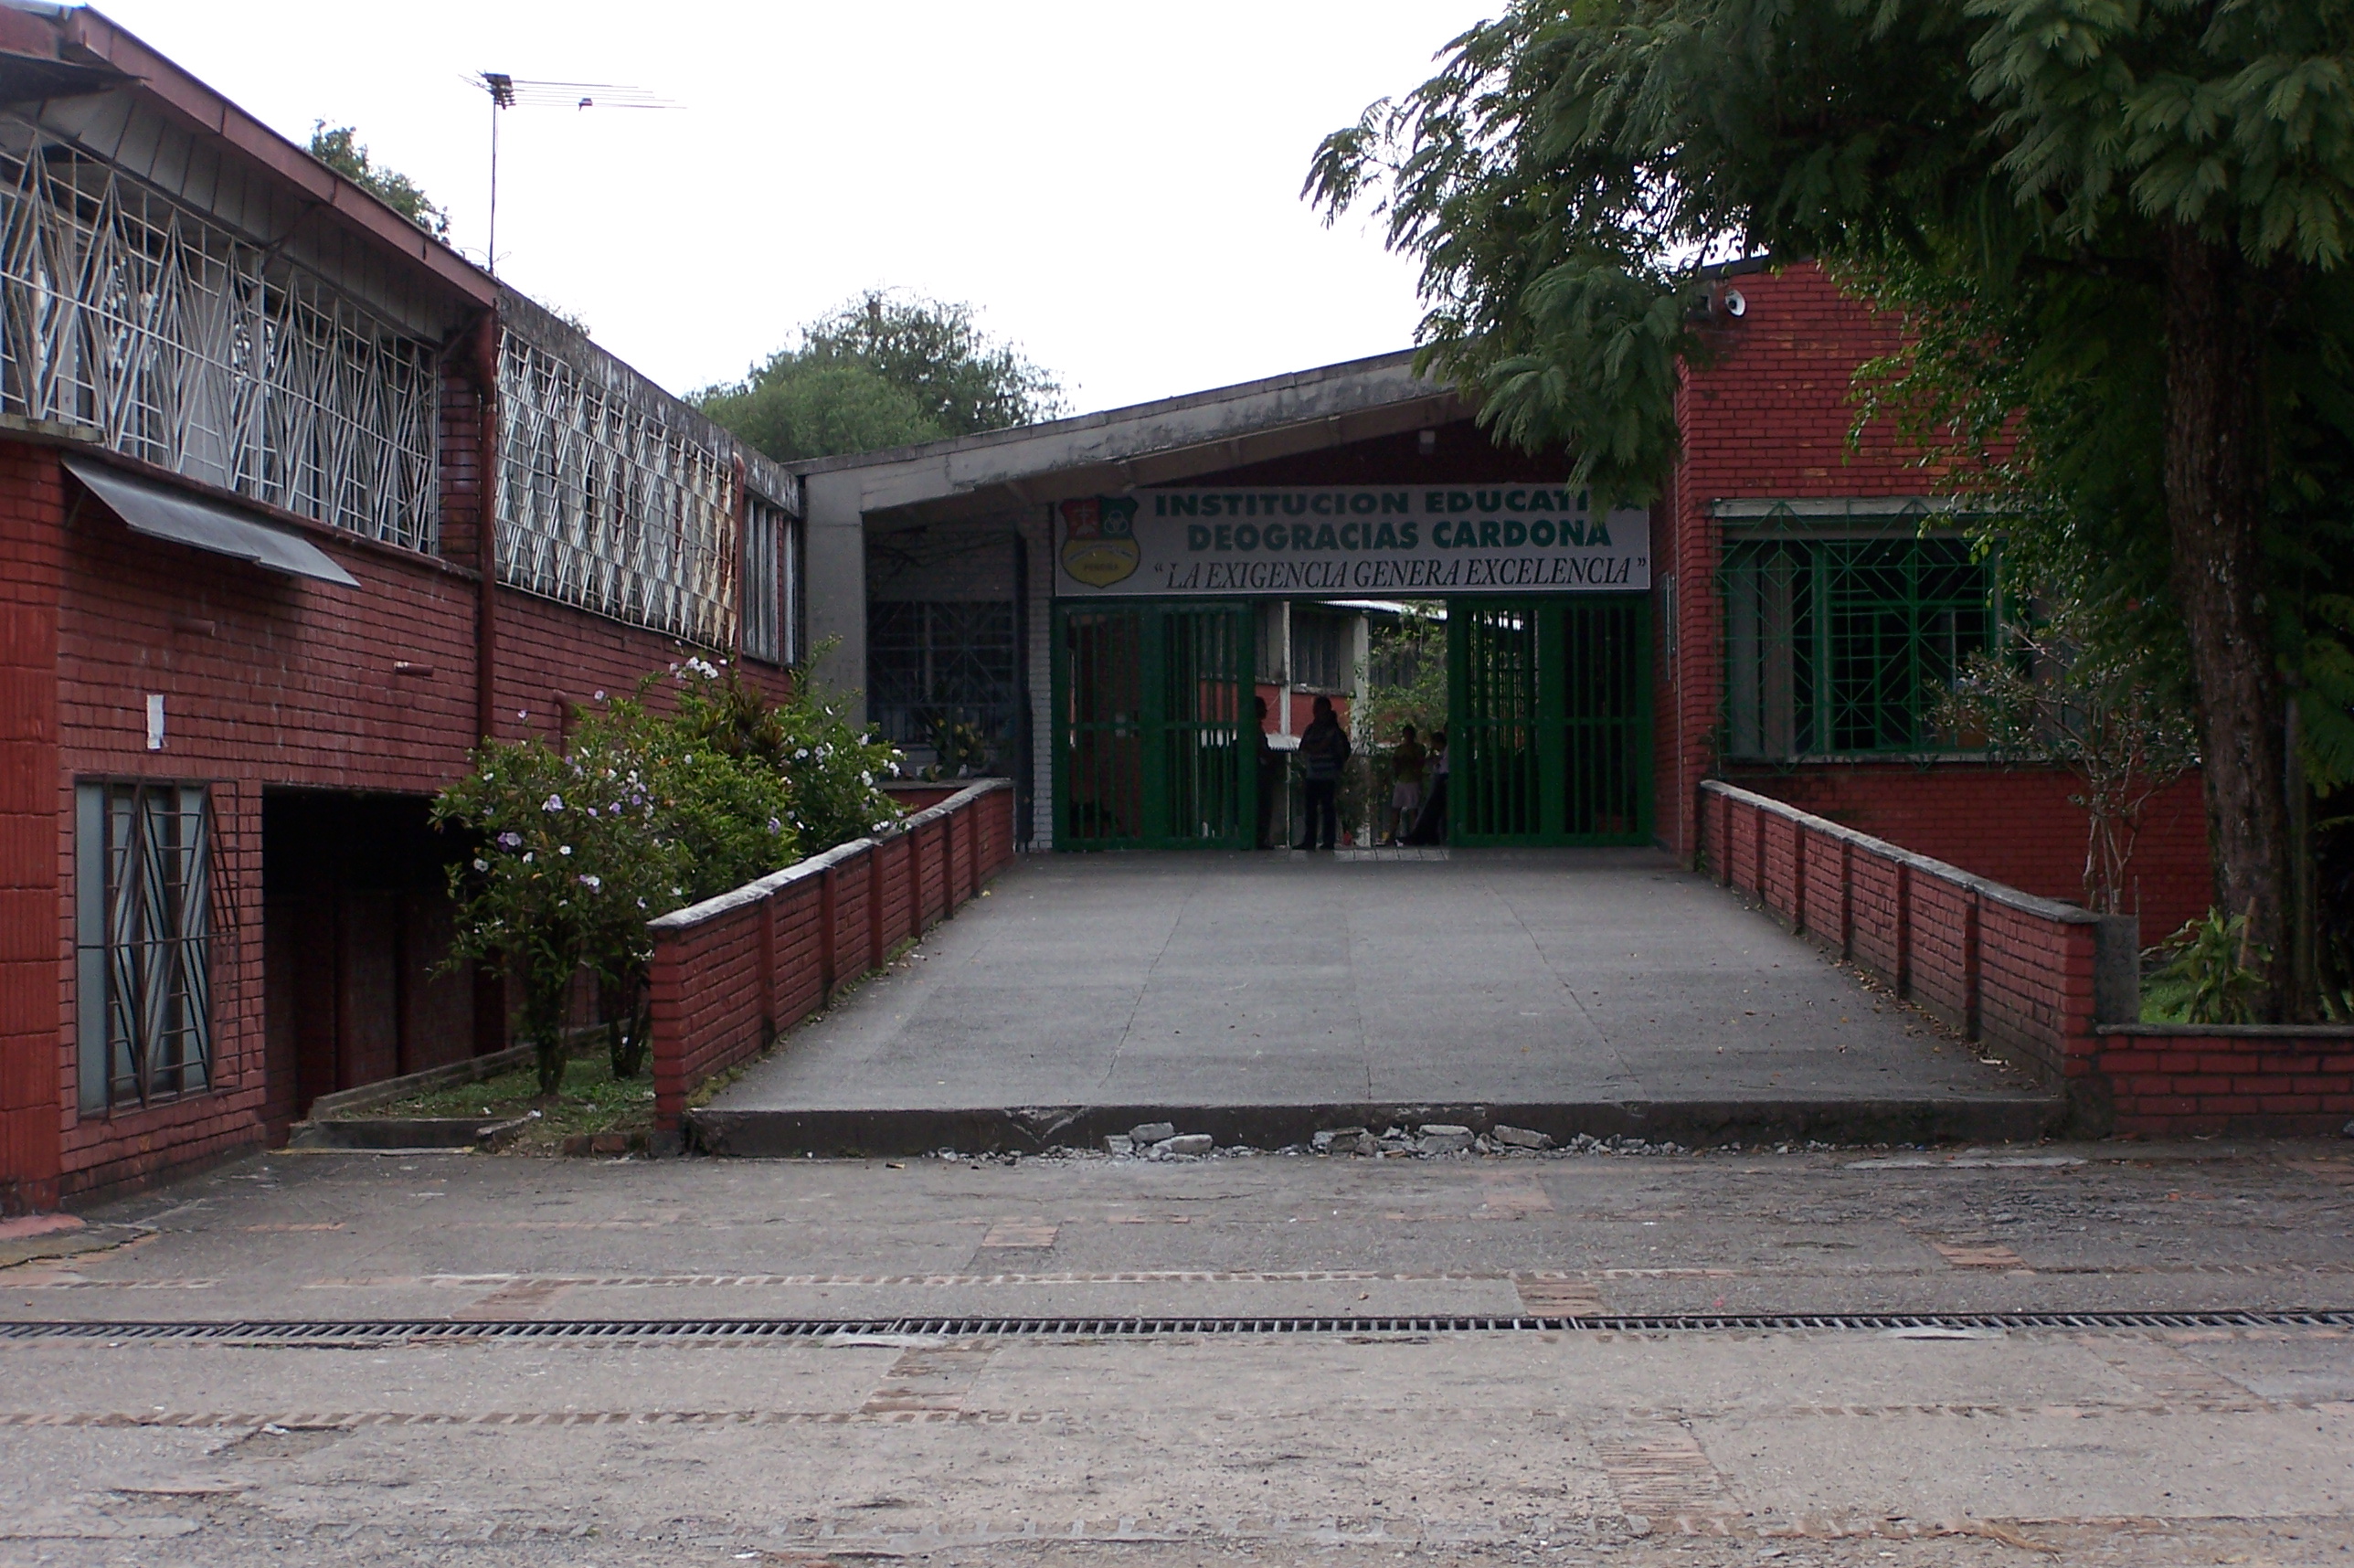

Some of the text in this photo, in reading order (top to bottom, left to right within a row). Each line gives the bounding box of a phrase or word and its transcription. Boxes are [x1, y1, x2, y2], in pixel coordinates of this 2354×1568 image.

[1155, 492, 1409, 516] INSTITUCION
[1188, 519, 1612, 552] DEOGRACIAS CARDONA
[1204, 560, 1348, 589] EXIGENCIA
[1353, 558, 1459, 588] GENERA
